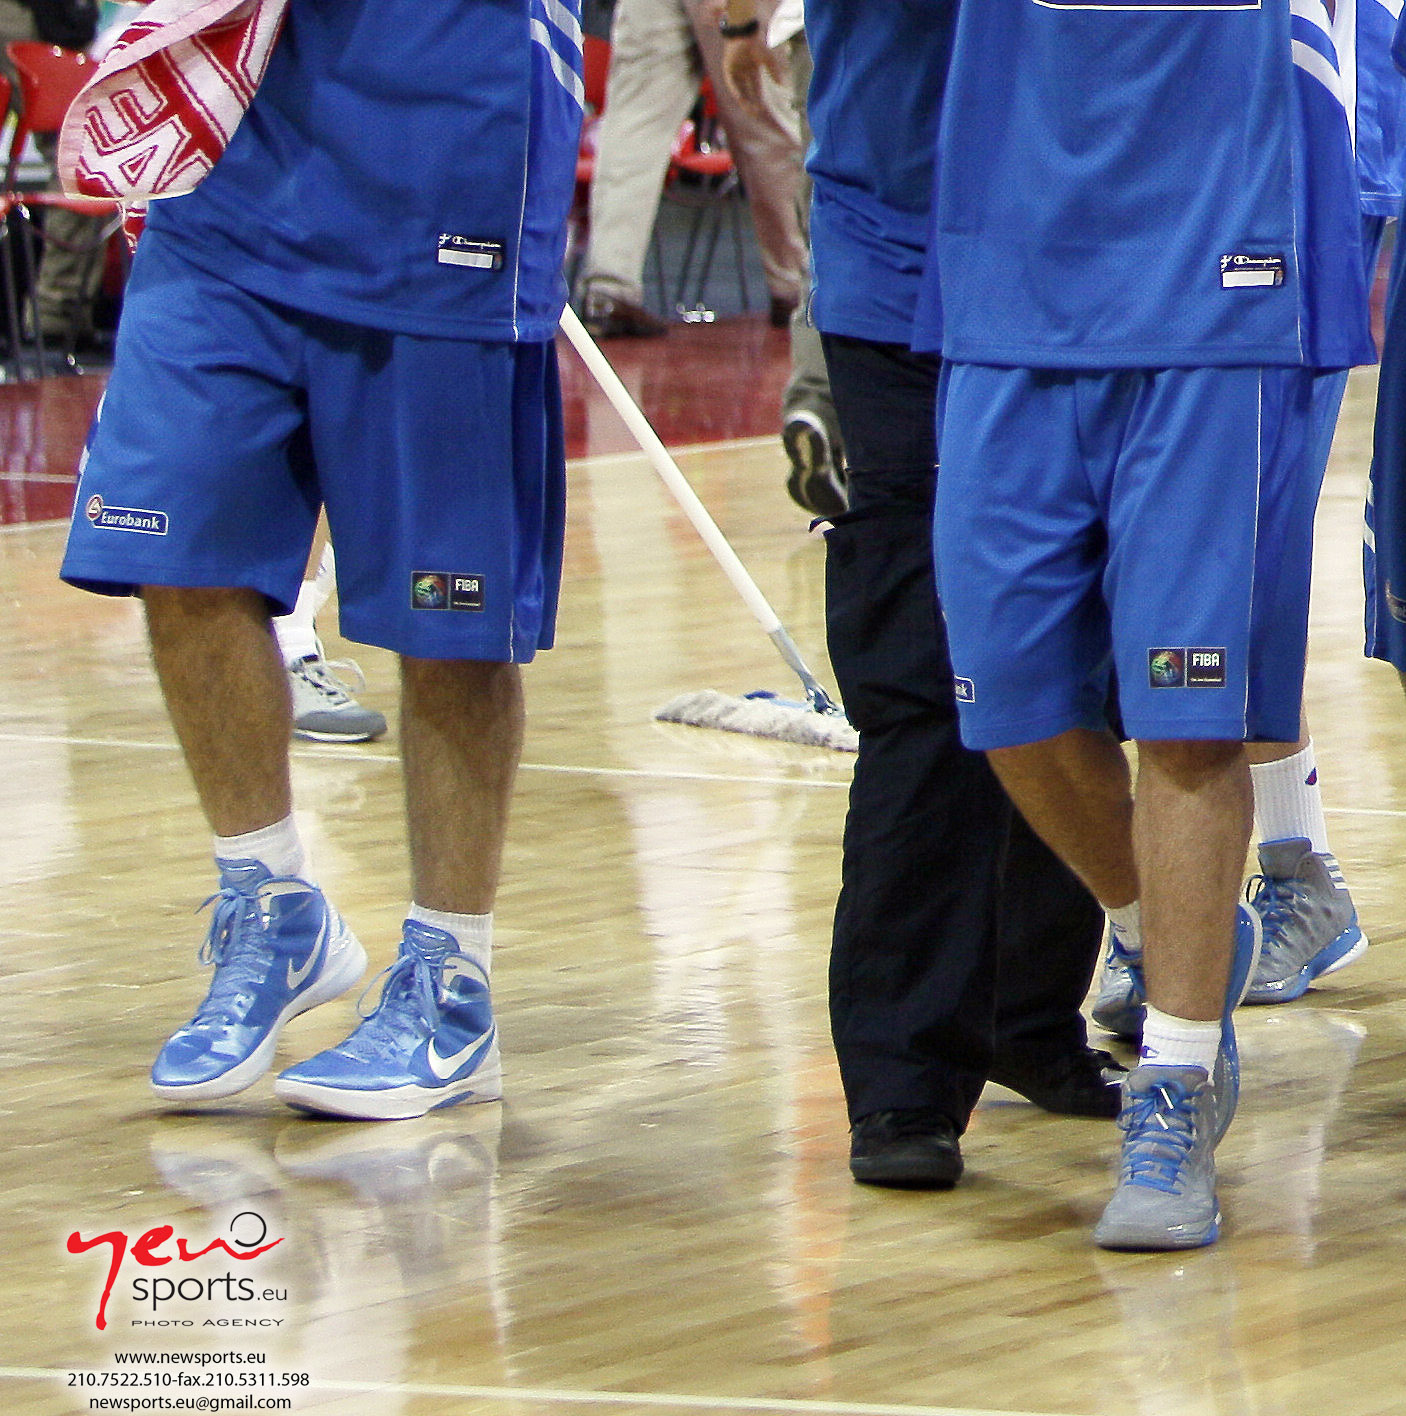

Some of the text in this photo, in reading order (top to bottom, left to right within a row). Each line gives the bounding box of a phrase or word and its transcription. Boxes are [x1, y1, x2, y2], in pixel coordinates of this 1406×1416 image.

[101, 511, 160, 531] Eurobank
[455, 578, 479, 593] FIBA
[1191, 652, 1220, 667] FIBA
